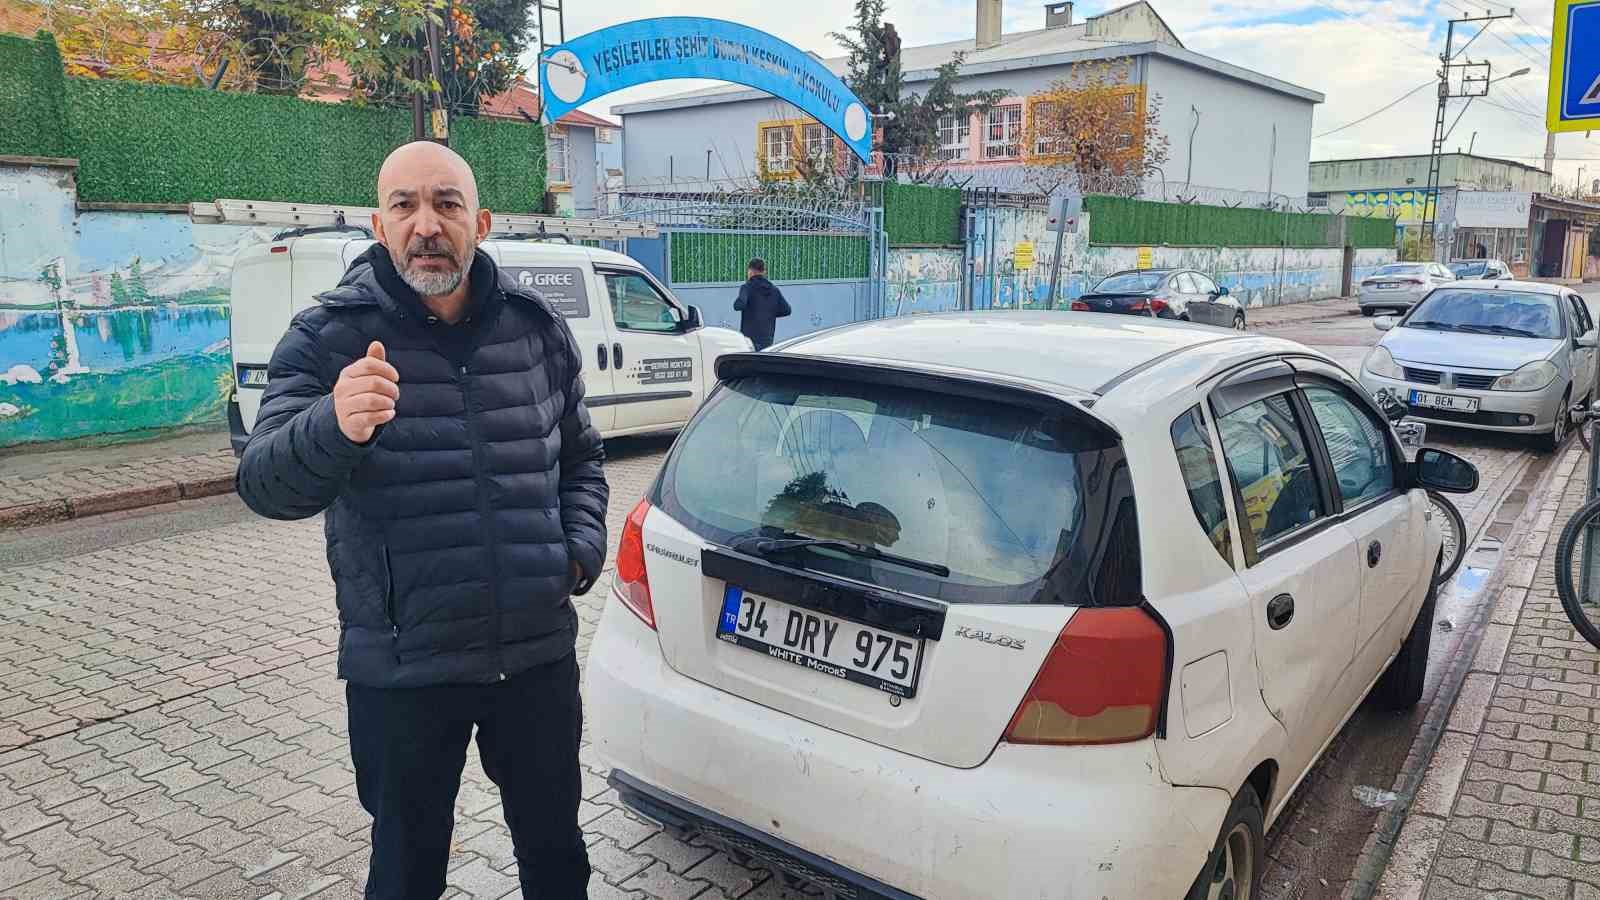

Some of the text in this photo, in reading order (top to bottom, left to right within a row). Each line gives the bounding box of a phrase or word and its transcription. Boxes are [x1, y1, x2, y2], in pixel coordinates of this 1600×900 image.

[593, 38, 672, 76] YEŞİLEVLER
[535, 273, 573, 286] GREE
[725, 611, 737, 625] TR
[738, 596, 914, 681] 34 DRY 975
[954, 625, 1027, 650] KALOS
[768, 645, 803, 666] WHITE
